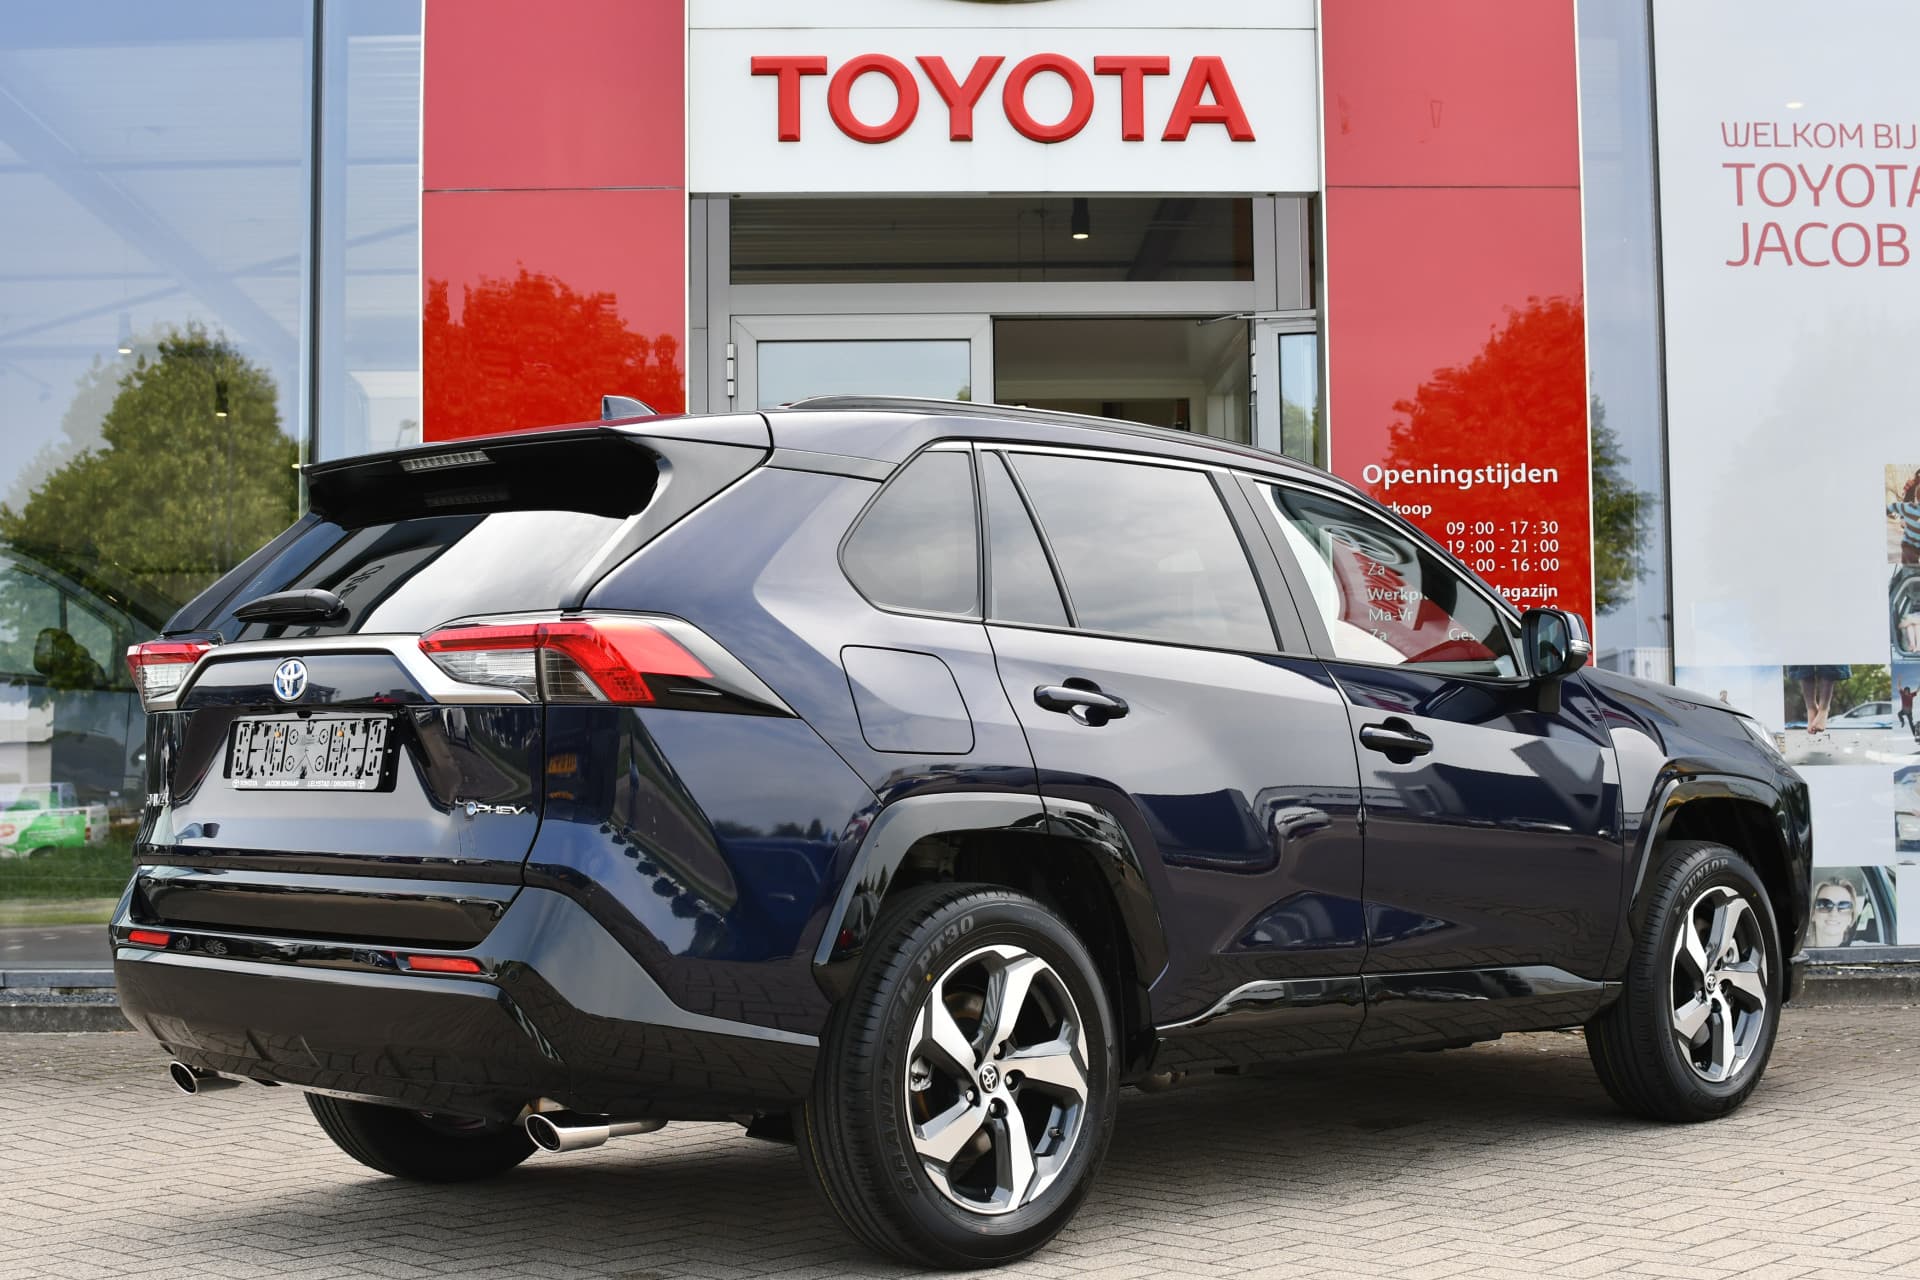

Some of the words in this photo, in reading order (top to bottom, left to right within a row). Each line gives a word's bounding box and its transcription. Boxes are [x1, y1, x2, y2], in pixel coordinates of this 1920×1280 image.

[750, 53, 1256, 144] TOYOTA
[1720, 121, 1864, 149] WELKOM
[1873, 123, 1917, 150] BIJ
[1725, 221, 1911, 268] JACOB
[1362, 462, 1559, 491] Openingstijden
[1386, 501, 1432, 519] koop
[1367, 562, 1385, 576] Za
[1368, 608, 1414, 621] Ma-Vr
[476, 803, 527, 815] PHEV
[1681, 858, 1729, 899] DUNLOP
[916, 915, 974, 973] PT30
